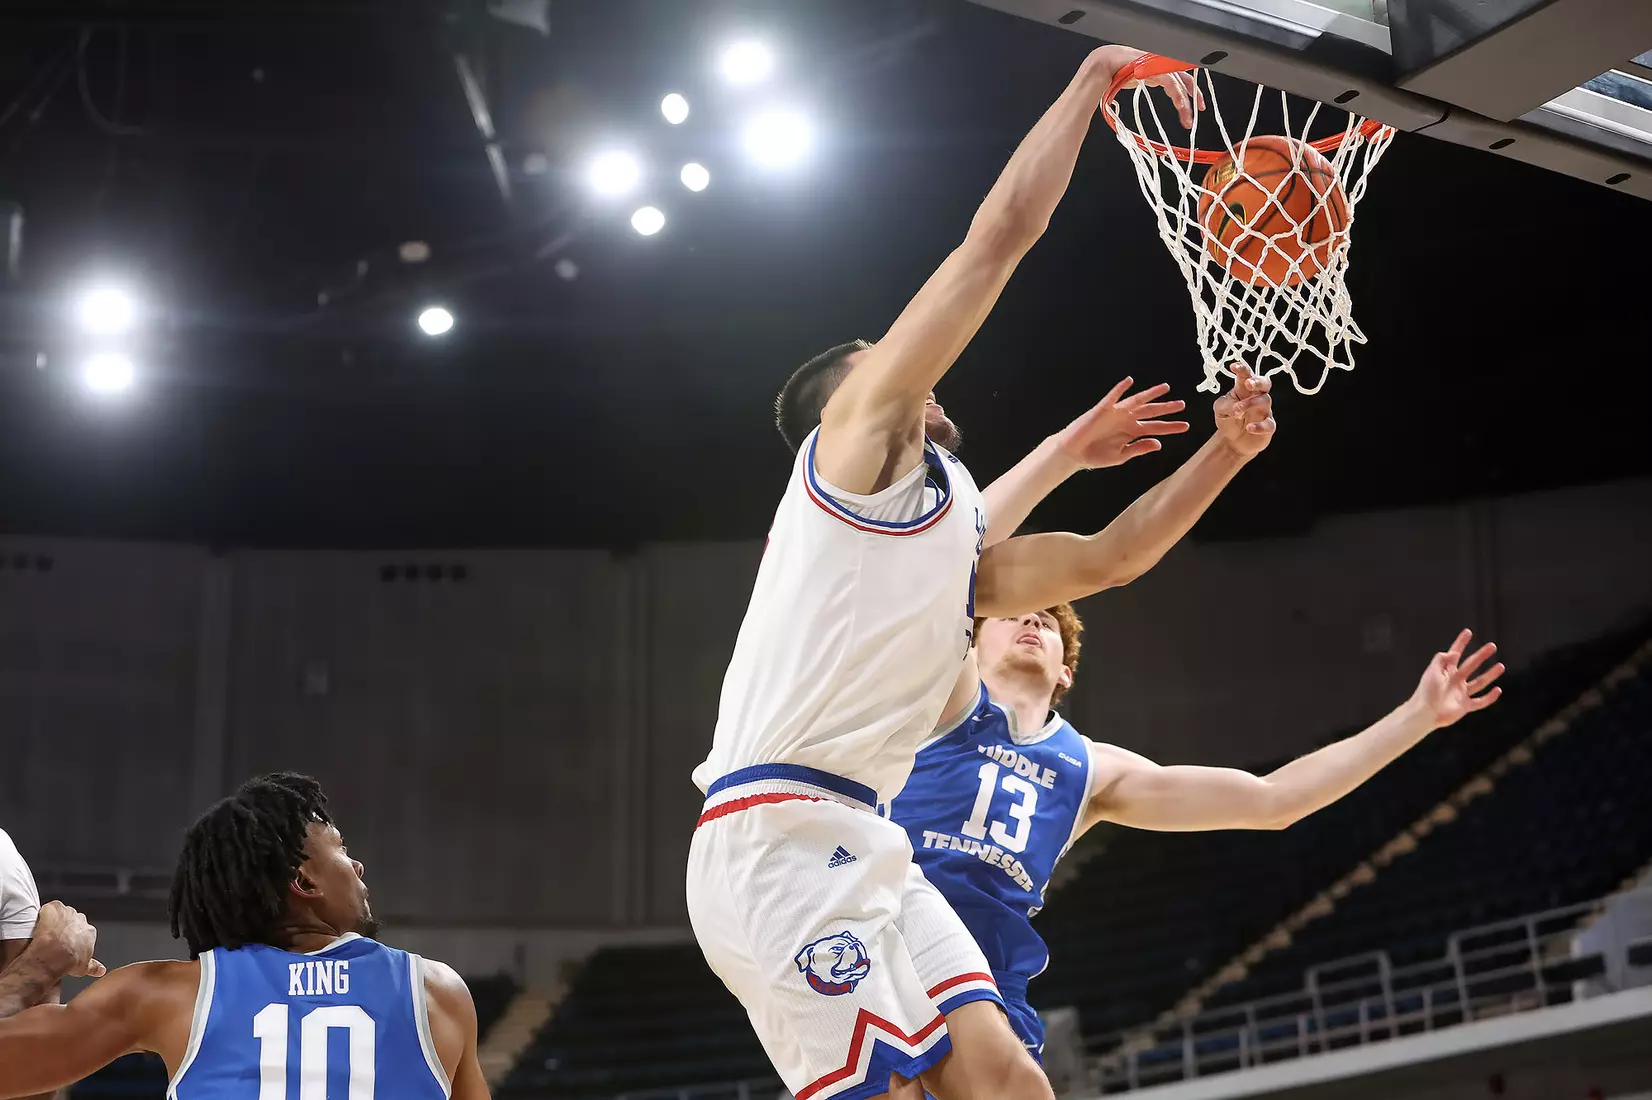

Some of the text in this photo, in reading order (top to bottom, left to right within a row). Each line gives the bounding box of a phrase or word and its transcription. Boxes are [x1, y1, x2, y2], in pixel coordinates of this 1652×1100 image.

[960, 761, 1038, 854] 13
[827, 855, 857, 868] adidas
[288, 960, 350, 996] KING
[253, 1003, 376, 1100] 10
